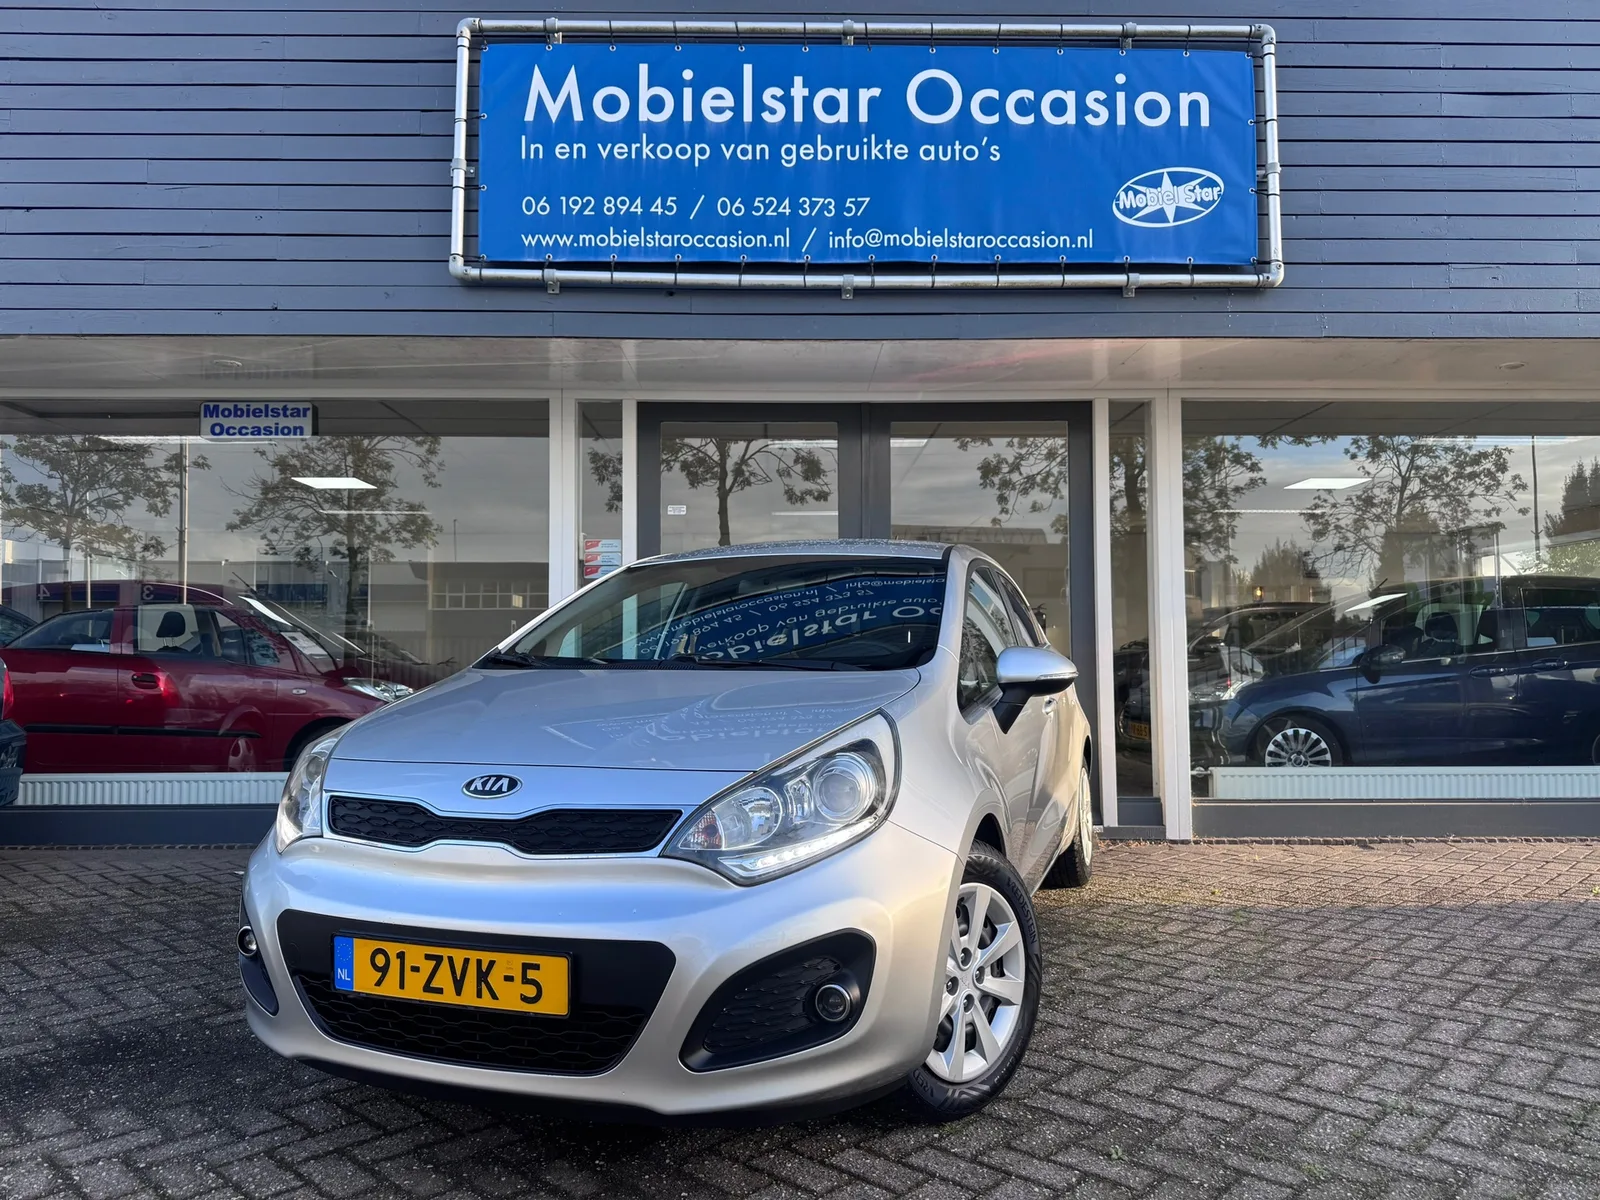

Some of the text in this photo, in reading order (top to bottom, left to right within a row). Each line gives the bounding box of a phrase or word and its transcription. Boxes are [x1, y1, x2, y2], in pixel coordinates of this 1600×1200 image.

[524, 63, 1210, 127] Mobielstar Occasion
[521, 133, 1001, 168] In en verkoop van gebruikte auto's
[522, 196, 550, 216] 06
[560, 196, 595, 215] 192
[603, 196, 643, 216] 894
[650, 196, 677, 216] 45
[717, 197, 745, 217] 06
[752, 197, 791, 216] 524
[798, 197, 836, 217] 373
[843, 197, 871, 217] 57
[1119, 184, 1221, 209] Mobiel Star
[521, 226, 790, 248] www.mobielstaroccasion.nl
[829, 227, 1093, 249] info@mobielstaroccasion.nl
[203, 403, 311, 419] Mobielstar
[210, 422, 305, 437] Occasion
[469, 776, 510, 792] KIA
[1006, 875, 1038, 945] VREDESTEIN
[337, 967, 351, 981] NL
[369, 947, 544, 1005] 91-ZVK-5
